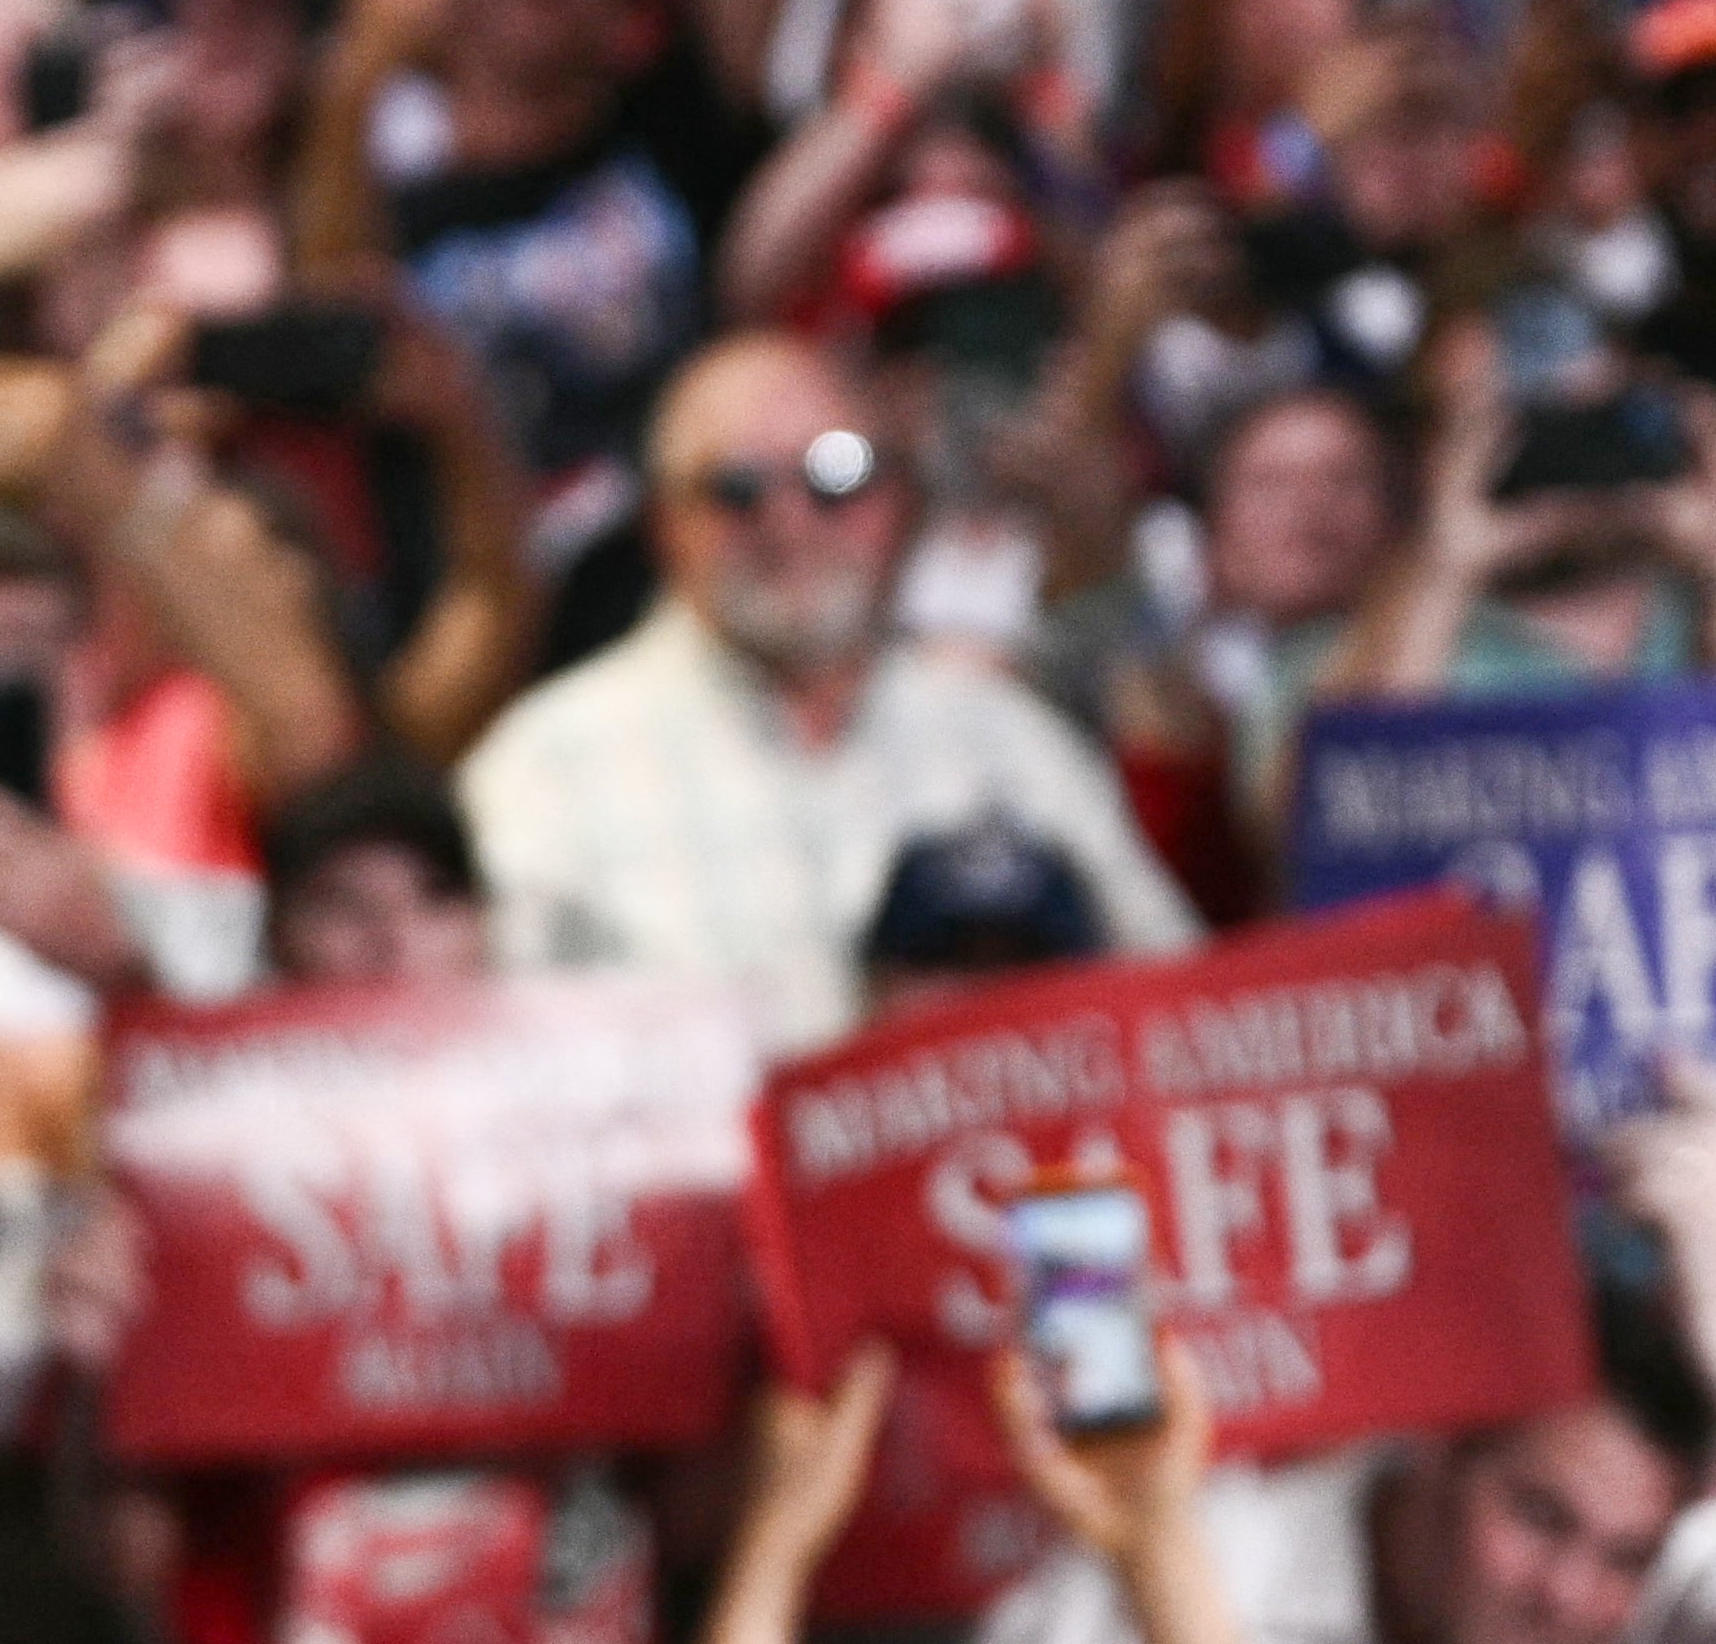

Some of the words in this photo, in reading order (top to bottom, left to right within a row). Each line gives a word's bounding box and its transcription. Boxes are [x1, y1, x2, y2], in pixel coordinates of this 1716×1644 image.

[789, 1014, 1125, 1188] MAKING
[1138, 962, 1530, 1092] AMERICA
[235, 1131, 655, 1334] SAFE
[925, 1086, 1417, 1344] SFE
